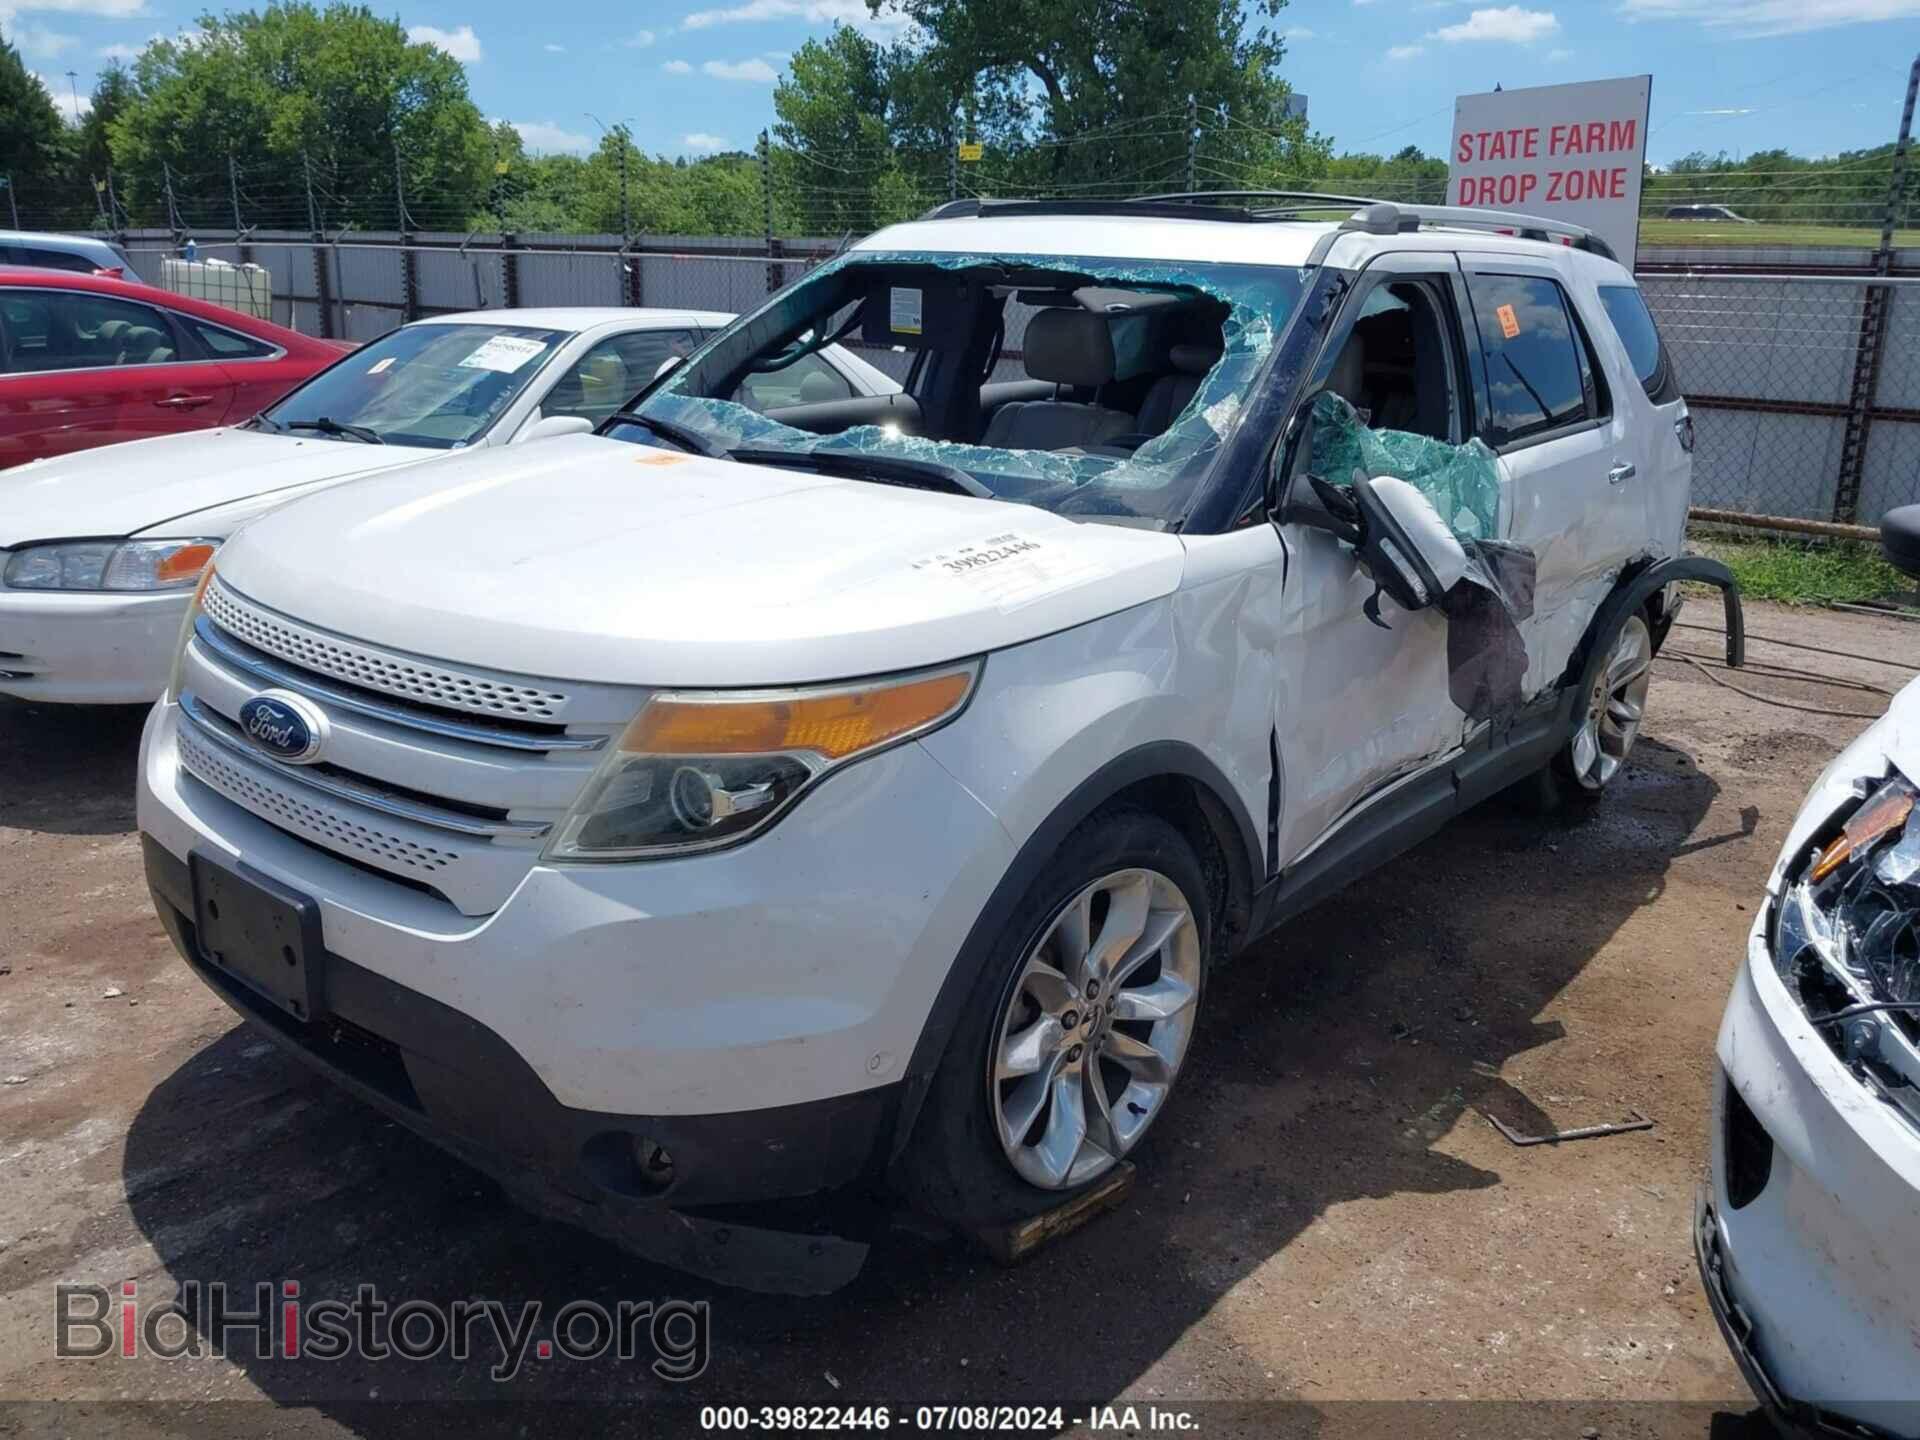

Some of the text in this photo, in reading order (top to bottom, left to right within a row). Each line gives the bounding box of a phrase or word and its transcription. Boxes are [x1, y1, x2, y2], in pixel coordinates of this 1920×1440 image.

[1457, 119, 1636, 163] STATE FARM
[1459, 167, 1627, 206] DROP ZONE
[250, 705, 294, 747] Ford
